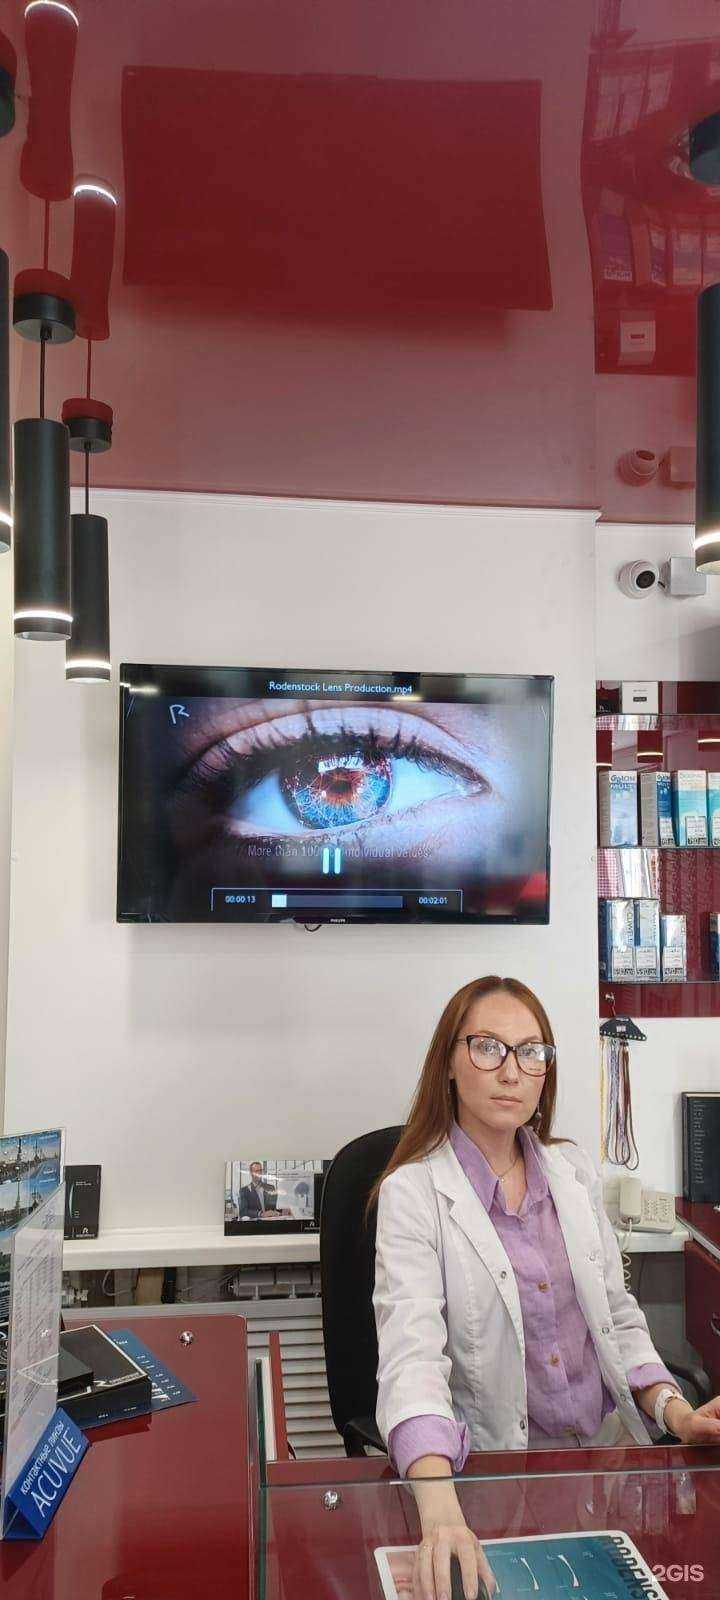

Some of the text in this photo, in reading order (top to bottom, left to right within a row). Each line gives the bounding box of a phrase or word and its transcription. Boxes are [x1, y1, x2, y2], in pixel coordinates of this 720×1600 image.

[268, 681, 412, 695] Rodenstock Lens Production.mp4
[248, 845, 272, 857] More
[275, 846, 298, 857] than
[418, 896, 449, 905] 00:02:01
[31, 1427, 81, 1518] ACUVUE
